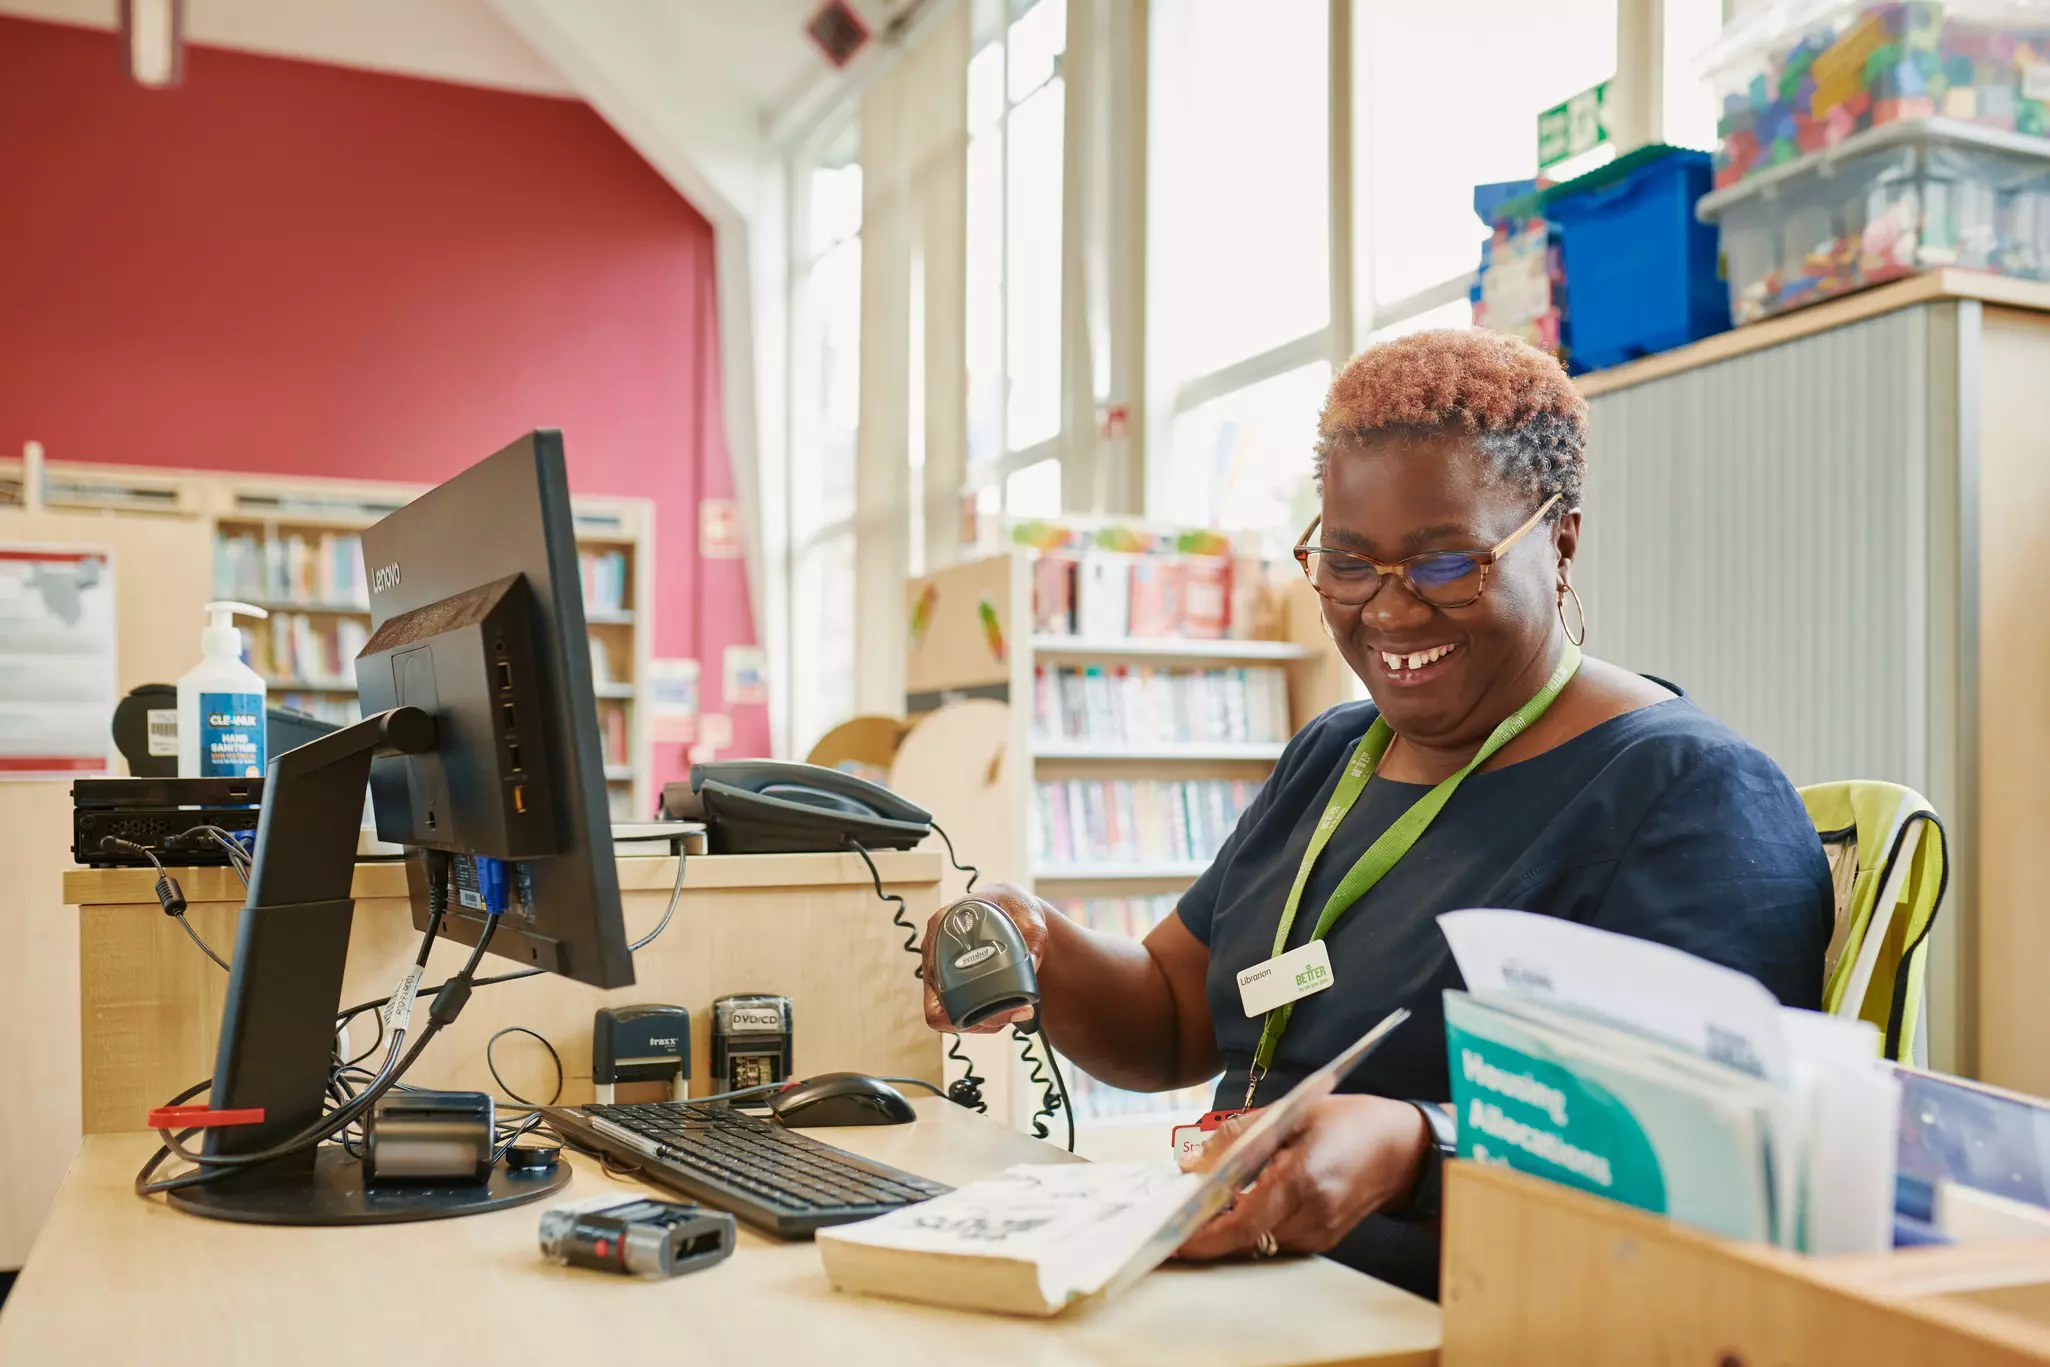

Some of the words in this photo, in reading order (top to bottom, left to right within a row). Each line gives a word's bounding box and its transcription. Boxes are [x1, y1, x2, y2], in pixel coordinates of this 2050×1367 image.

[371, 561, 400, 593] Lenovo
[1240, 968, 1272, 987] Librarian
[1295, 964, 1327, 986] BETTER
[733, 1014, 778, 1025] DVD/CD
[649, 1037, 676, 1047] traxx
[1461, 1048, 1569, 1127] Housing
[1468, 1098, 1613, 1187] Allocations
